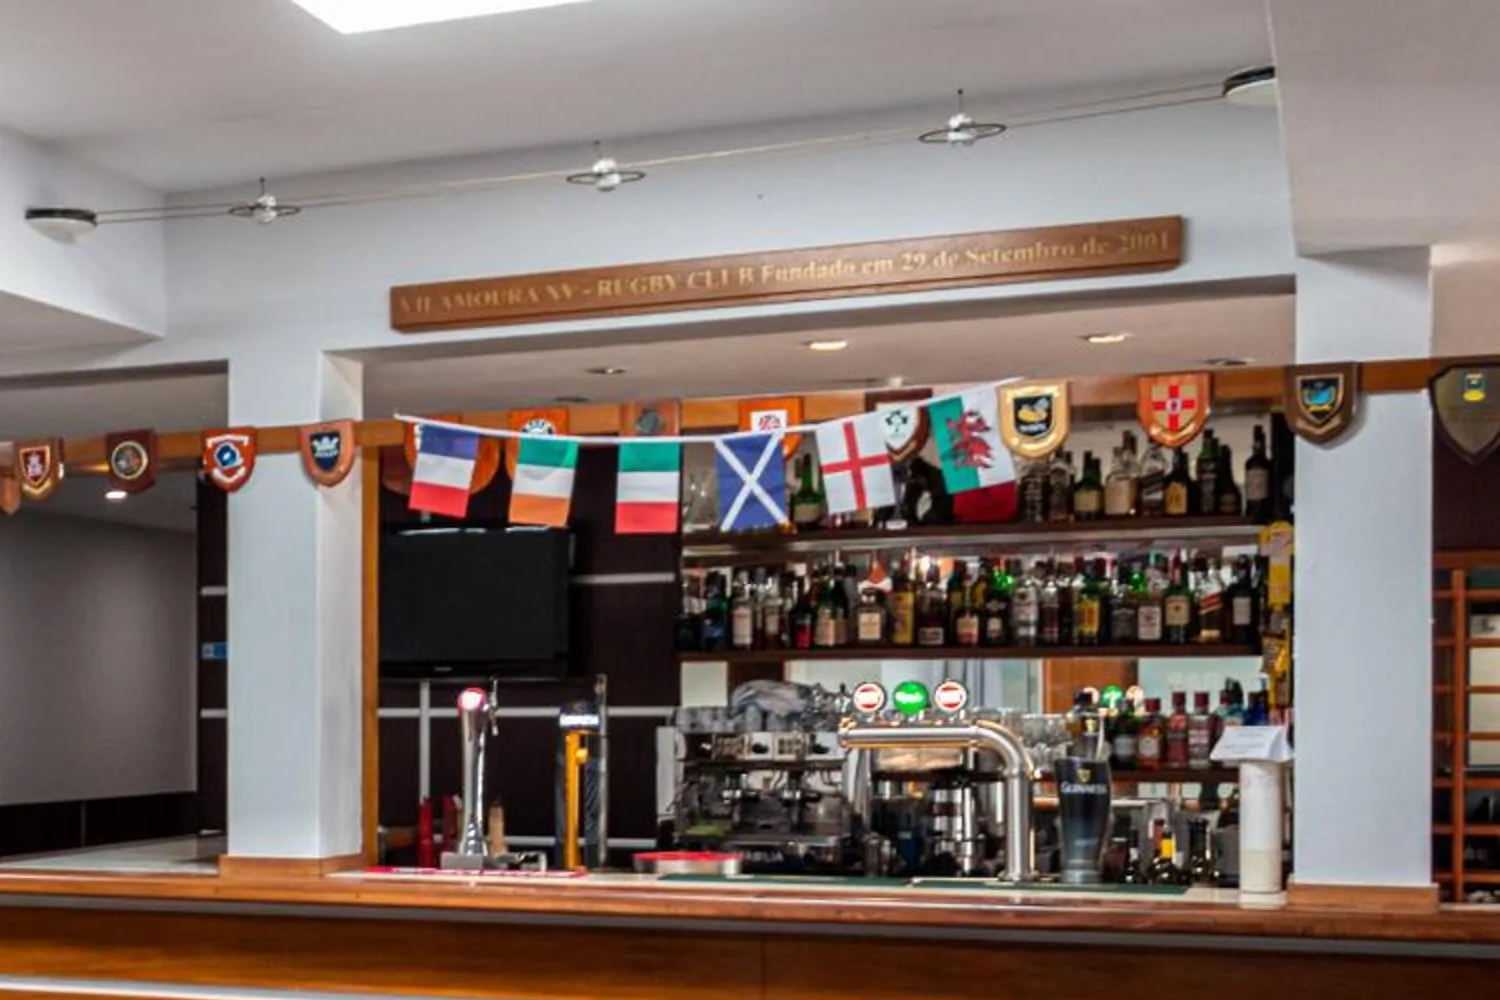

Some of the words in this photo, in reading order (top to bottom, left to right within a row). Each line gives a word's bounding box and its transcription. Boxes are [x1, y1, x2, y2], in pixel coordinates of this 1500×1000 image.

[597, 274, 677, 297] RUGBY
[762, 260, 855, 283] Fundado
[861, 258, 894, 275] em
[933, 250, 959, 267] de
[965, 241, 1076, 267] Setembro
[1083, 236, 1109, 255] de
[1060, 780, 1108, 796] GUINNESS
